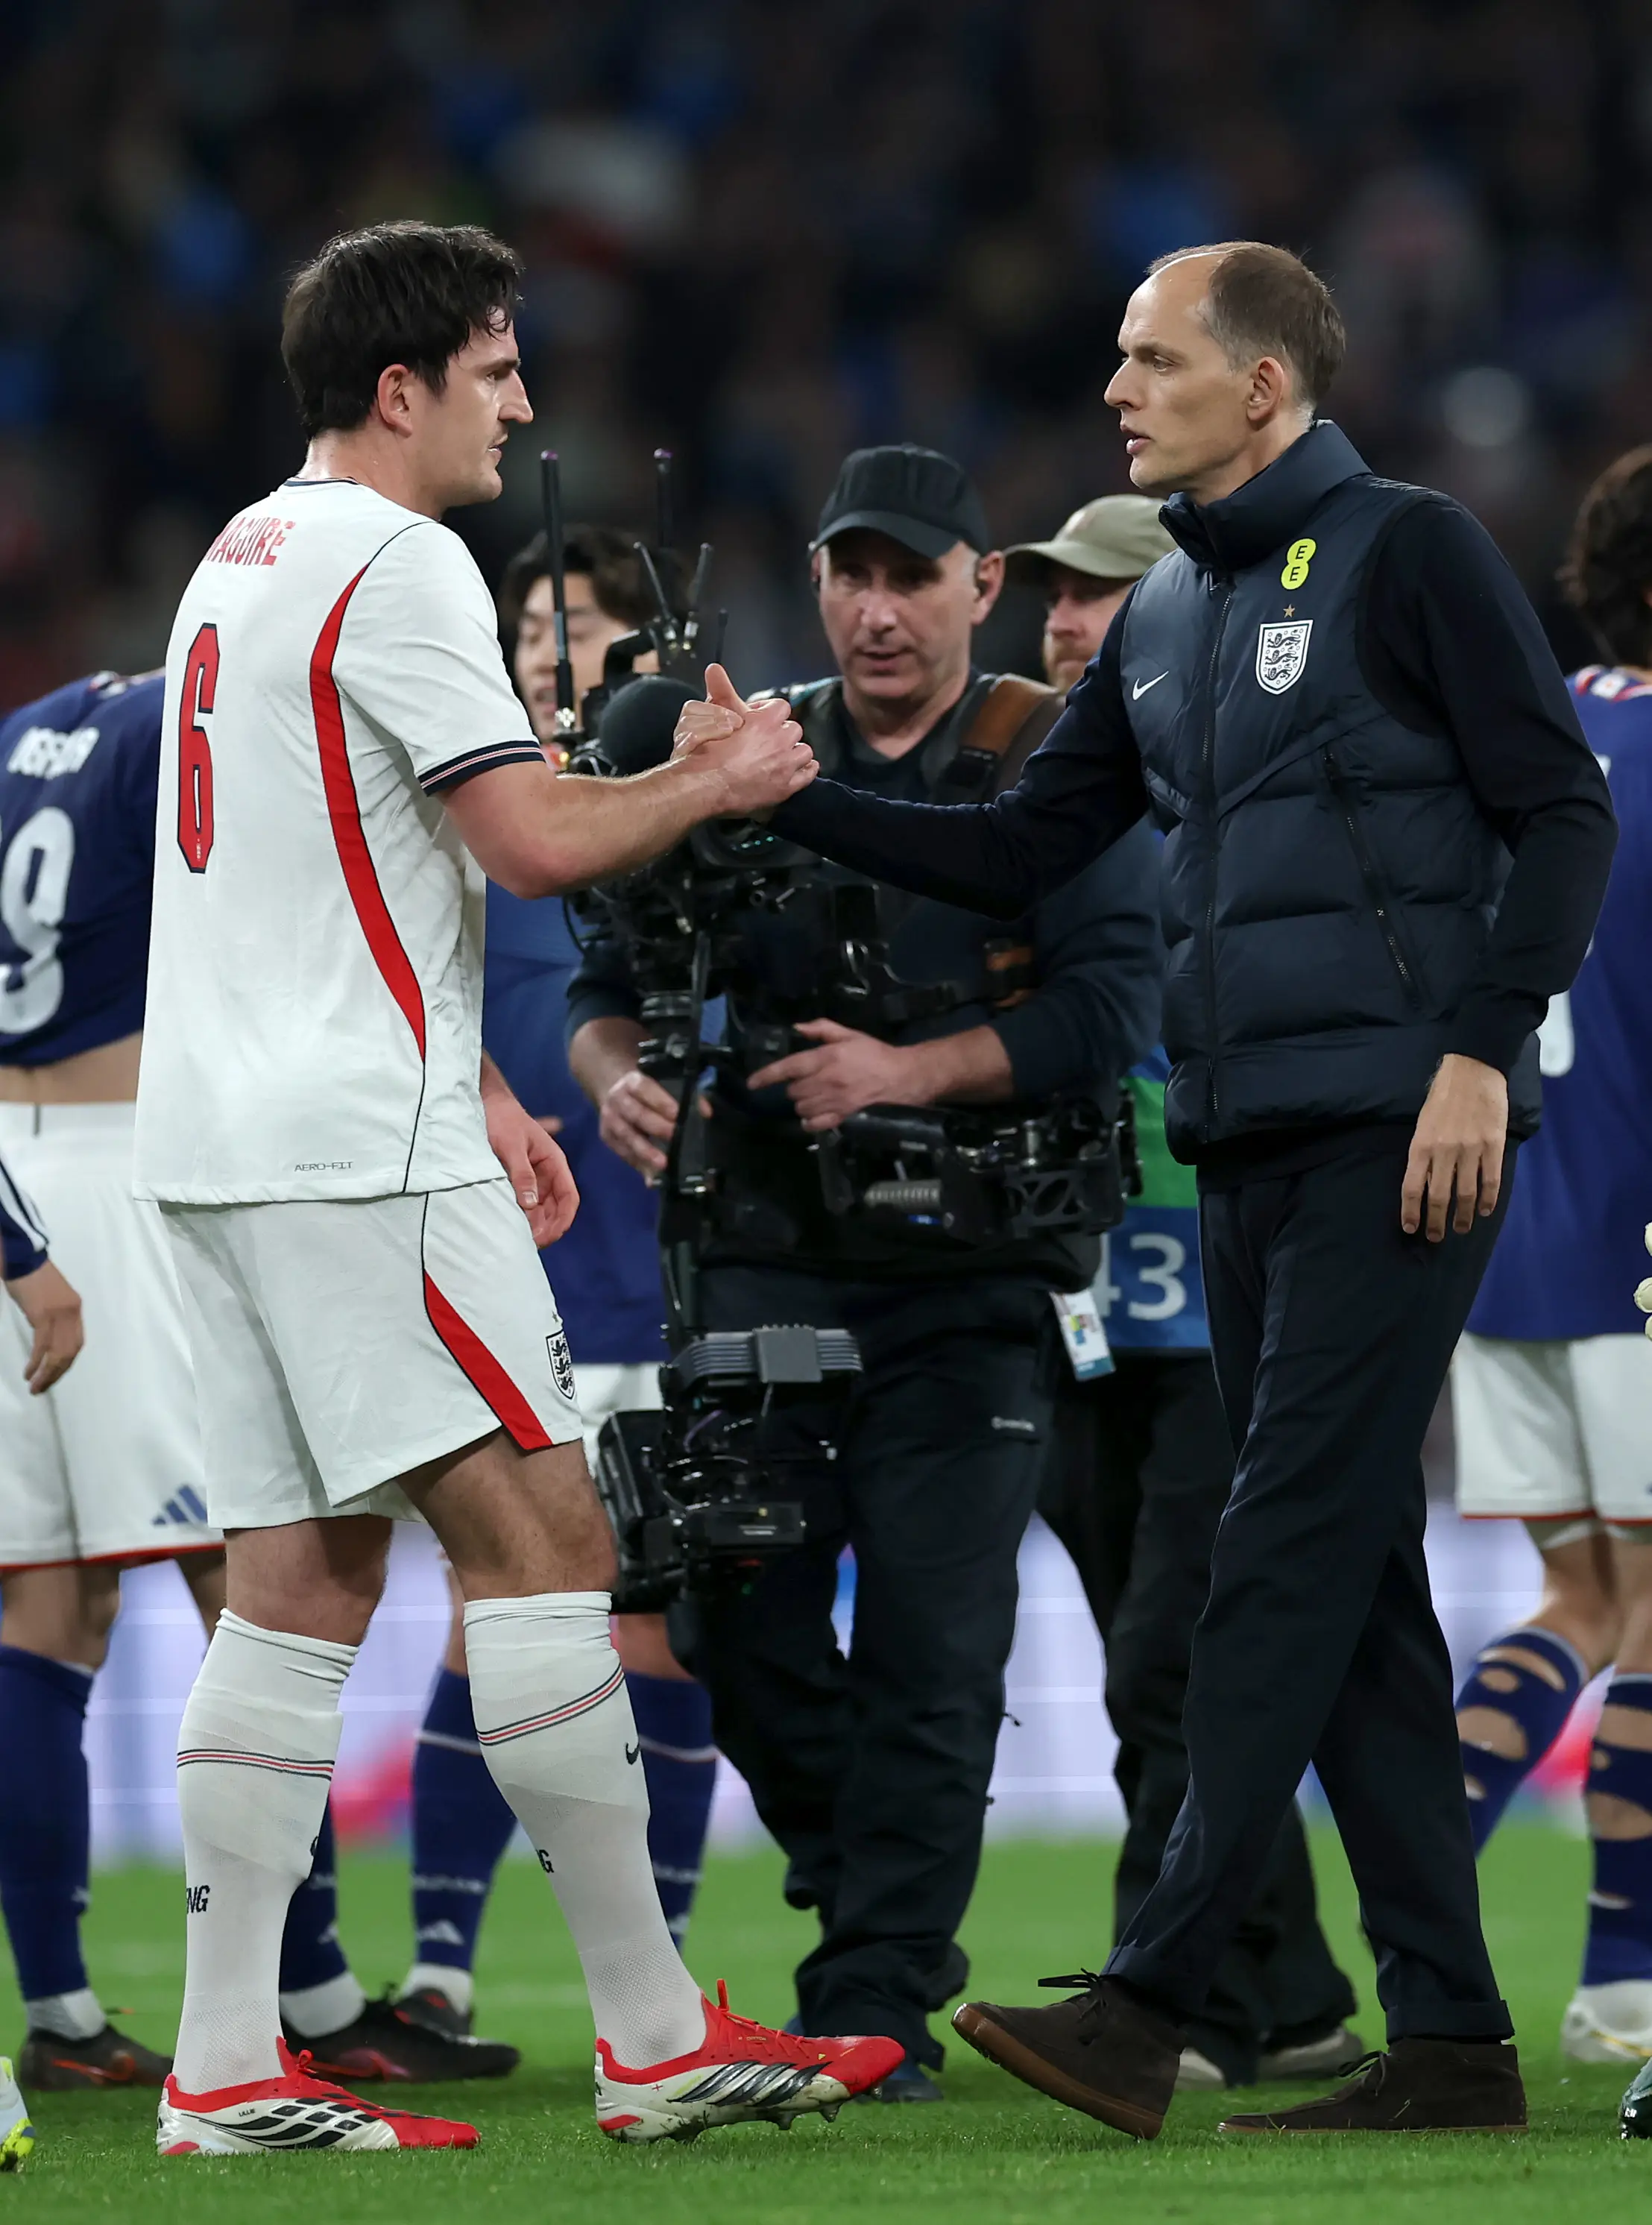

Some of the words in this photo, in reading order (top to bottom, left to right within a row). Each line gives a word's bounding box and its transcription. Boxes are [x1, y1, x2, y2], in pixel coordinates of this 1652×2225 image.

[177, 623, 220, 873] 6
[0, 806, 75, 1034] 9
[294, 1161, 353, 1172] AERO-FIT
[186, 1884, 210, 1914] NG
